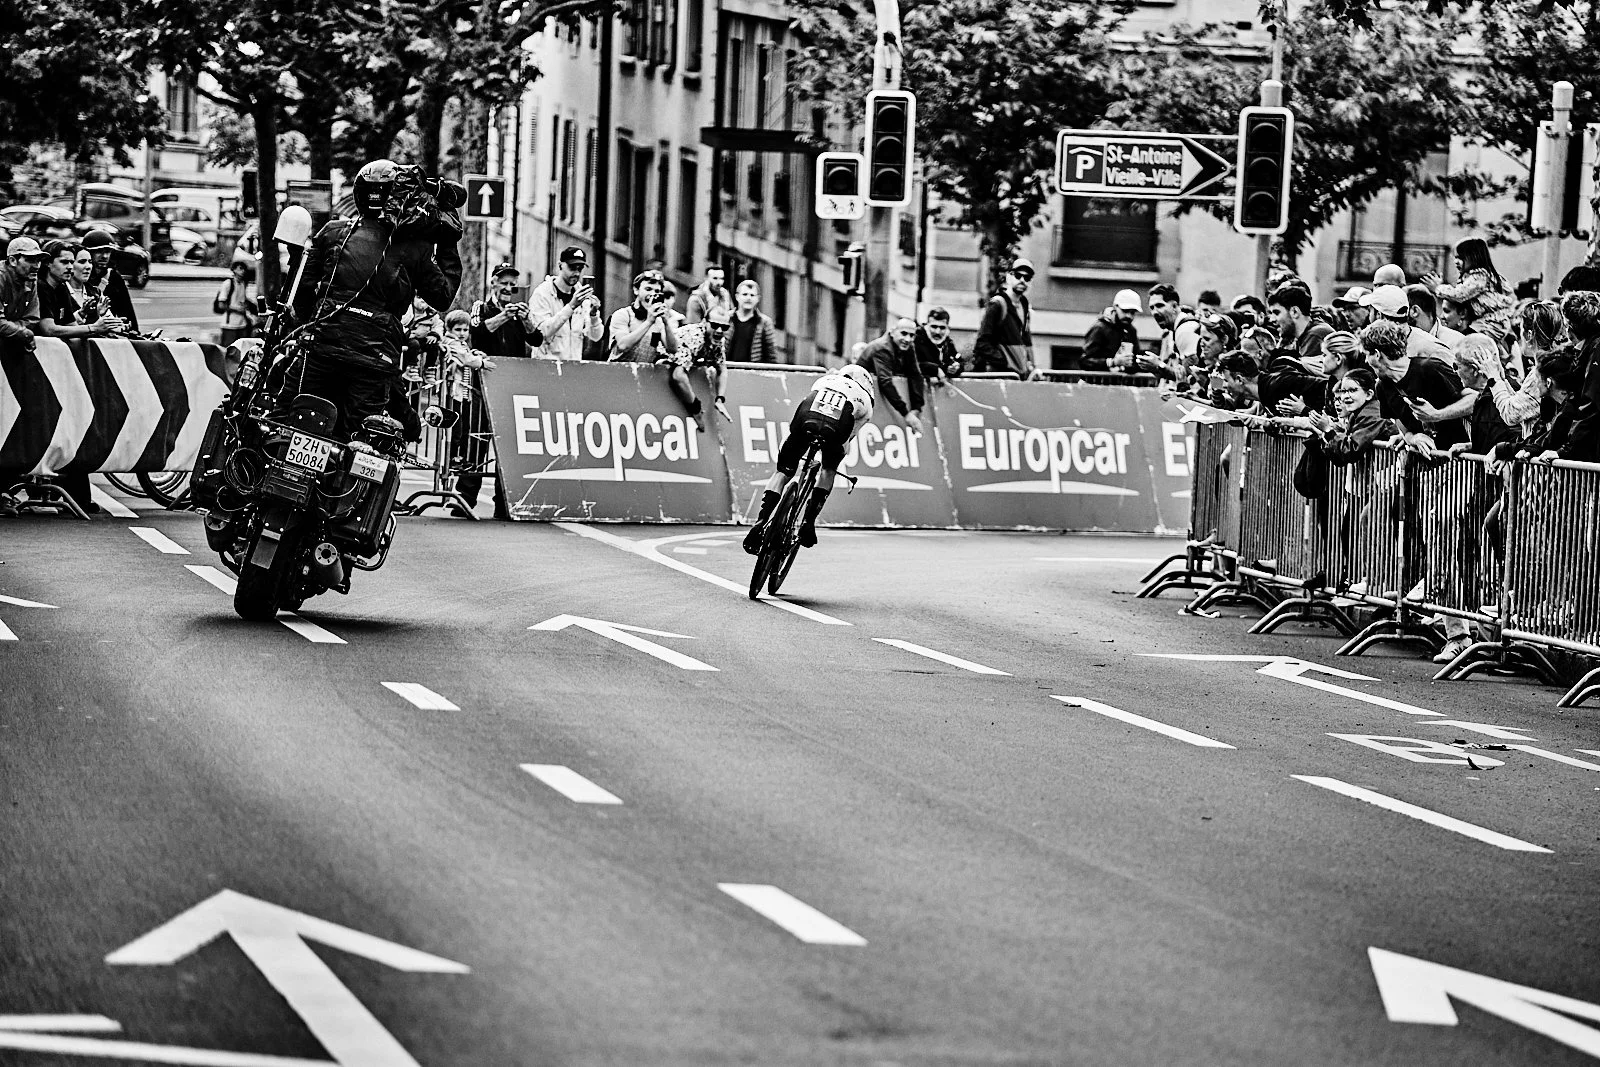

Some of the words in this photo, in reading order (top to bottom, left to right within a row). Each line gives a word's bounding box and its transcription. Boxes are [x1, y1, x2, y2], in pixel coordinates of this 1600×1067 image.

[1107, 145, 1182, 166] St-Antoine
[1075, 154, 1096, 180] P
[1106, 167, 1182, 188] Vieille-Ville
[302, 437, 321, 454] ZH
[512, 394, 700, 482] Europcar
[287, 448, 324, 472] 50084
[958, 413, 1131, 494] Europcar
[359, 466, 376, 478] 326
